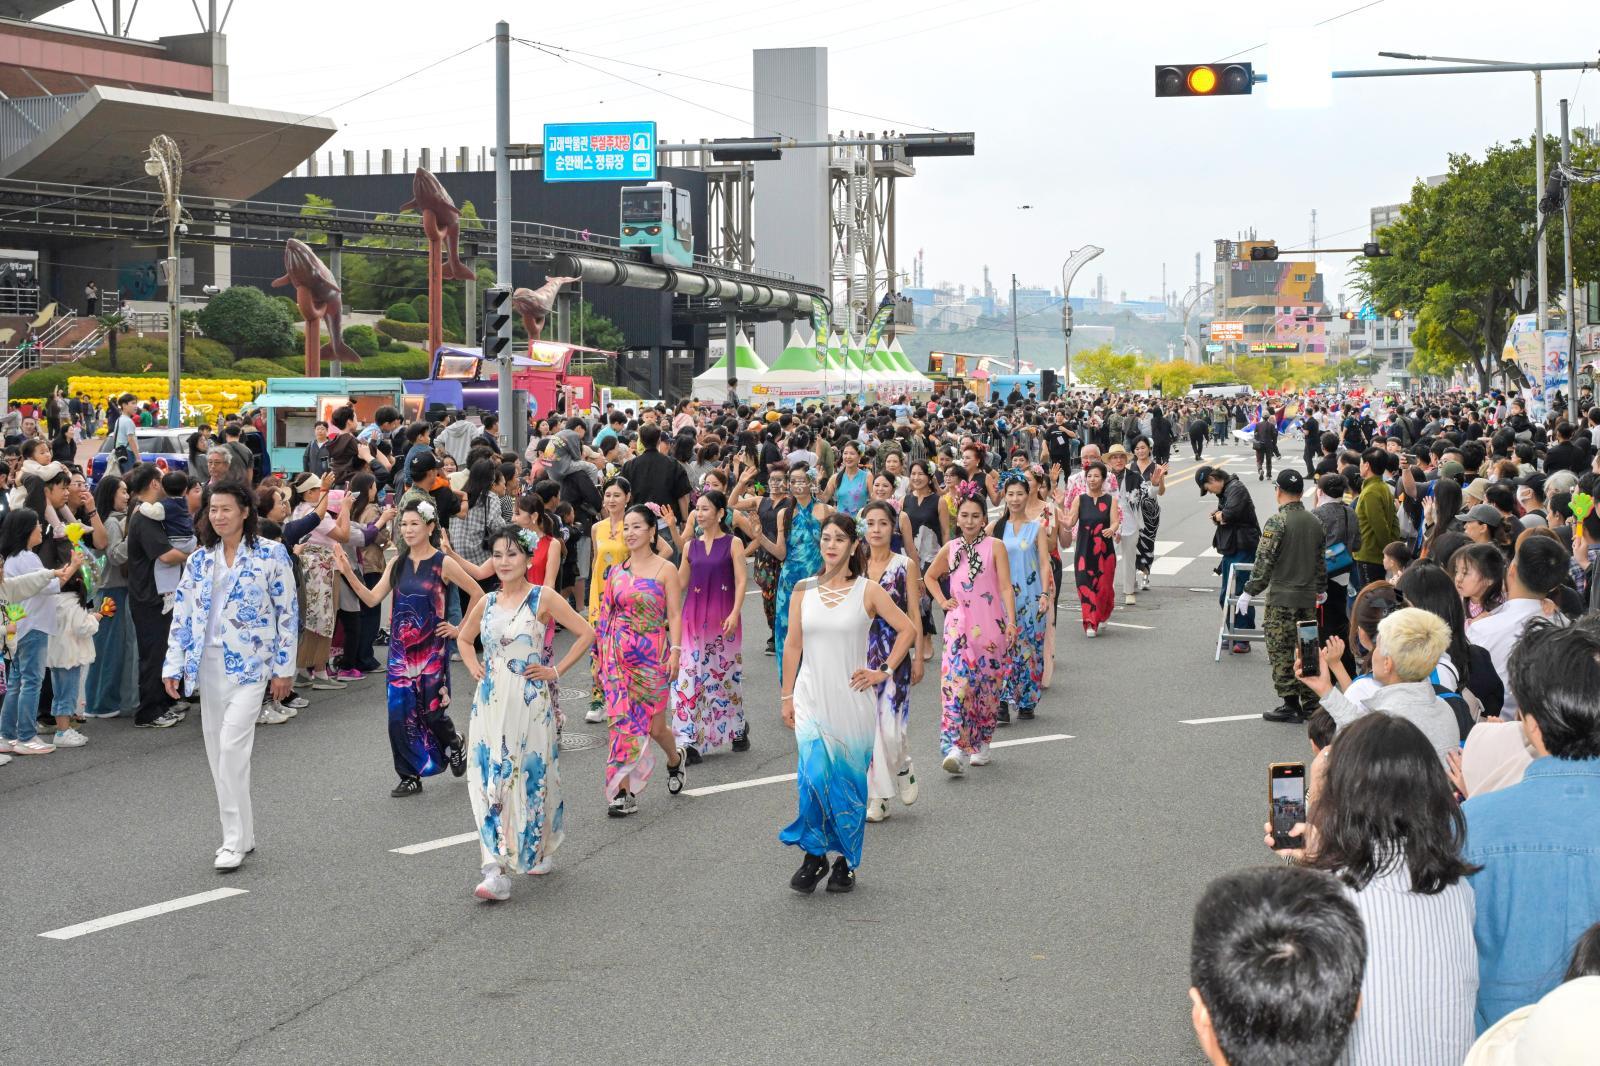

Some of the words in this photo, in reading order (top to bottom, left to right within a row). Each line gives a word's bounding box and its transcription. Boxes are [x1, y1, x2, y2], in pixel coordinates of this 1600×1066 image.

[548, 136, 588, 152] 고래박물관
[590, 134, 631, 152] 부설주차장
[555, 154, 593, 171] 순환버스
[595, 154, 625, 170] 정류장
